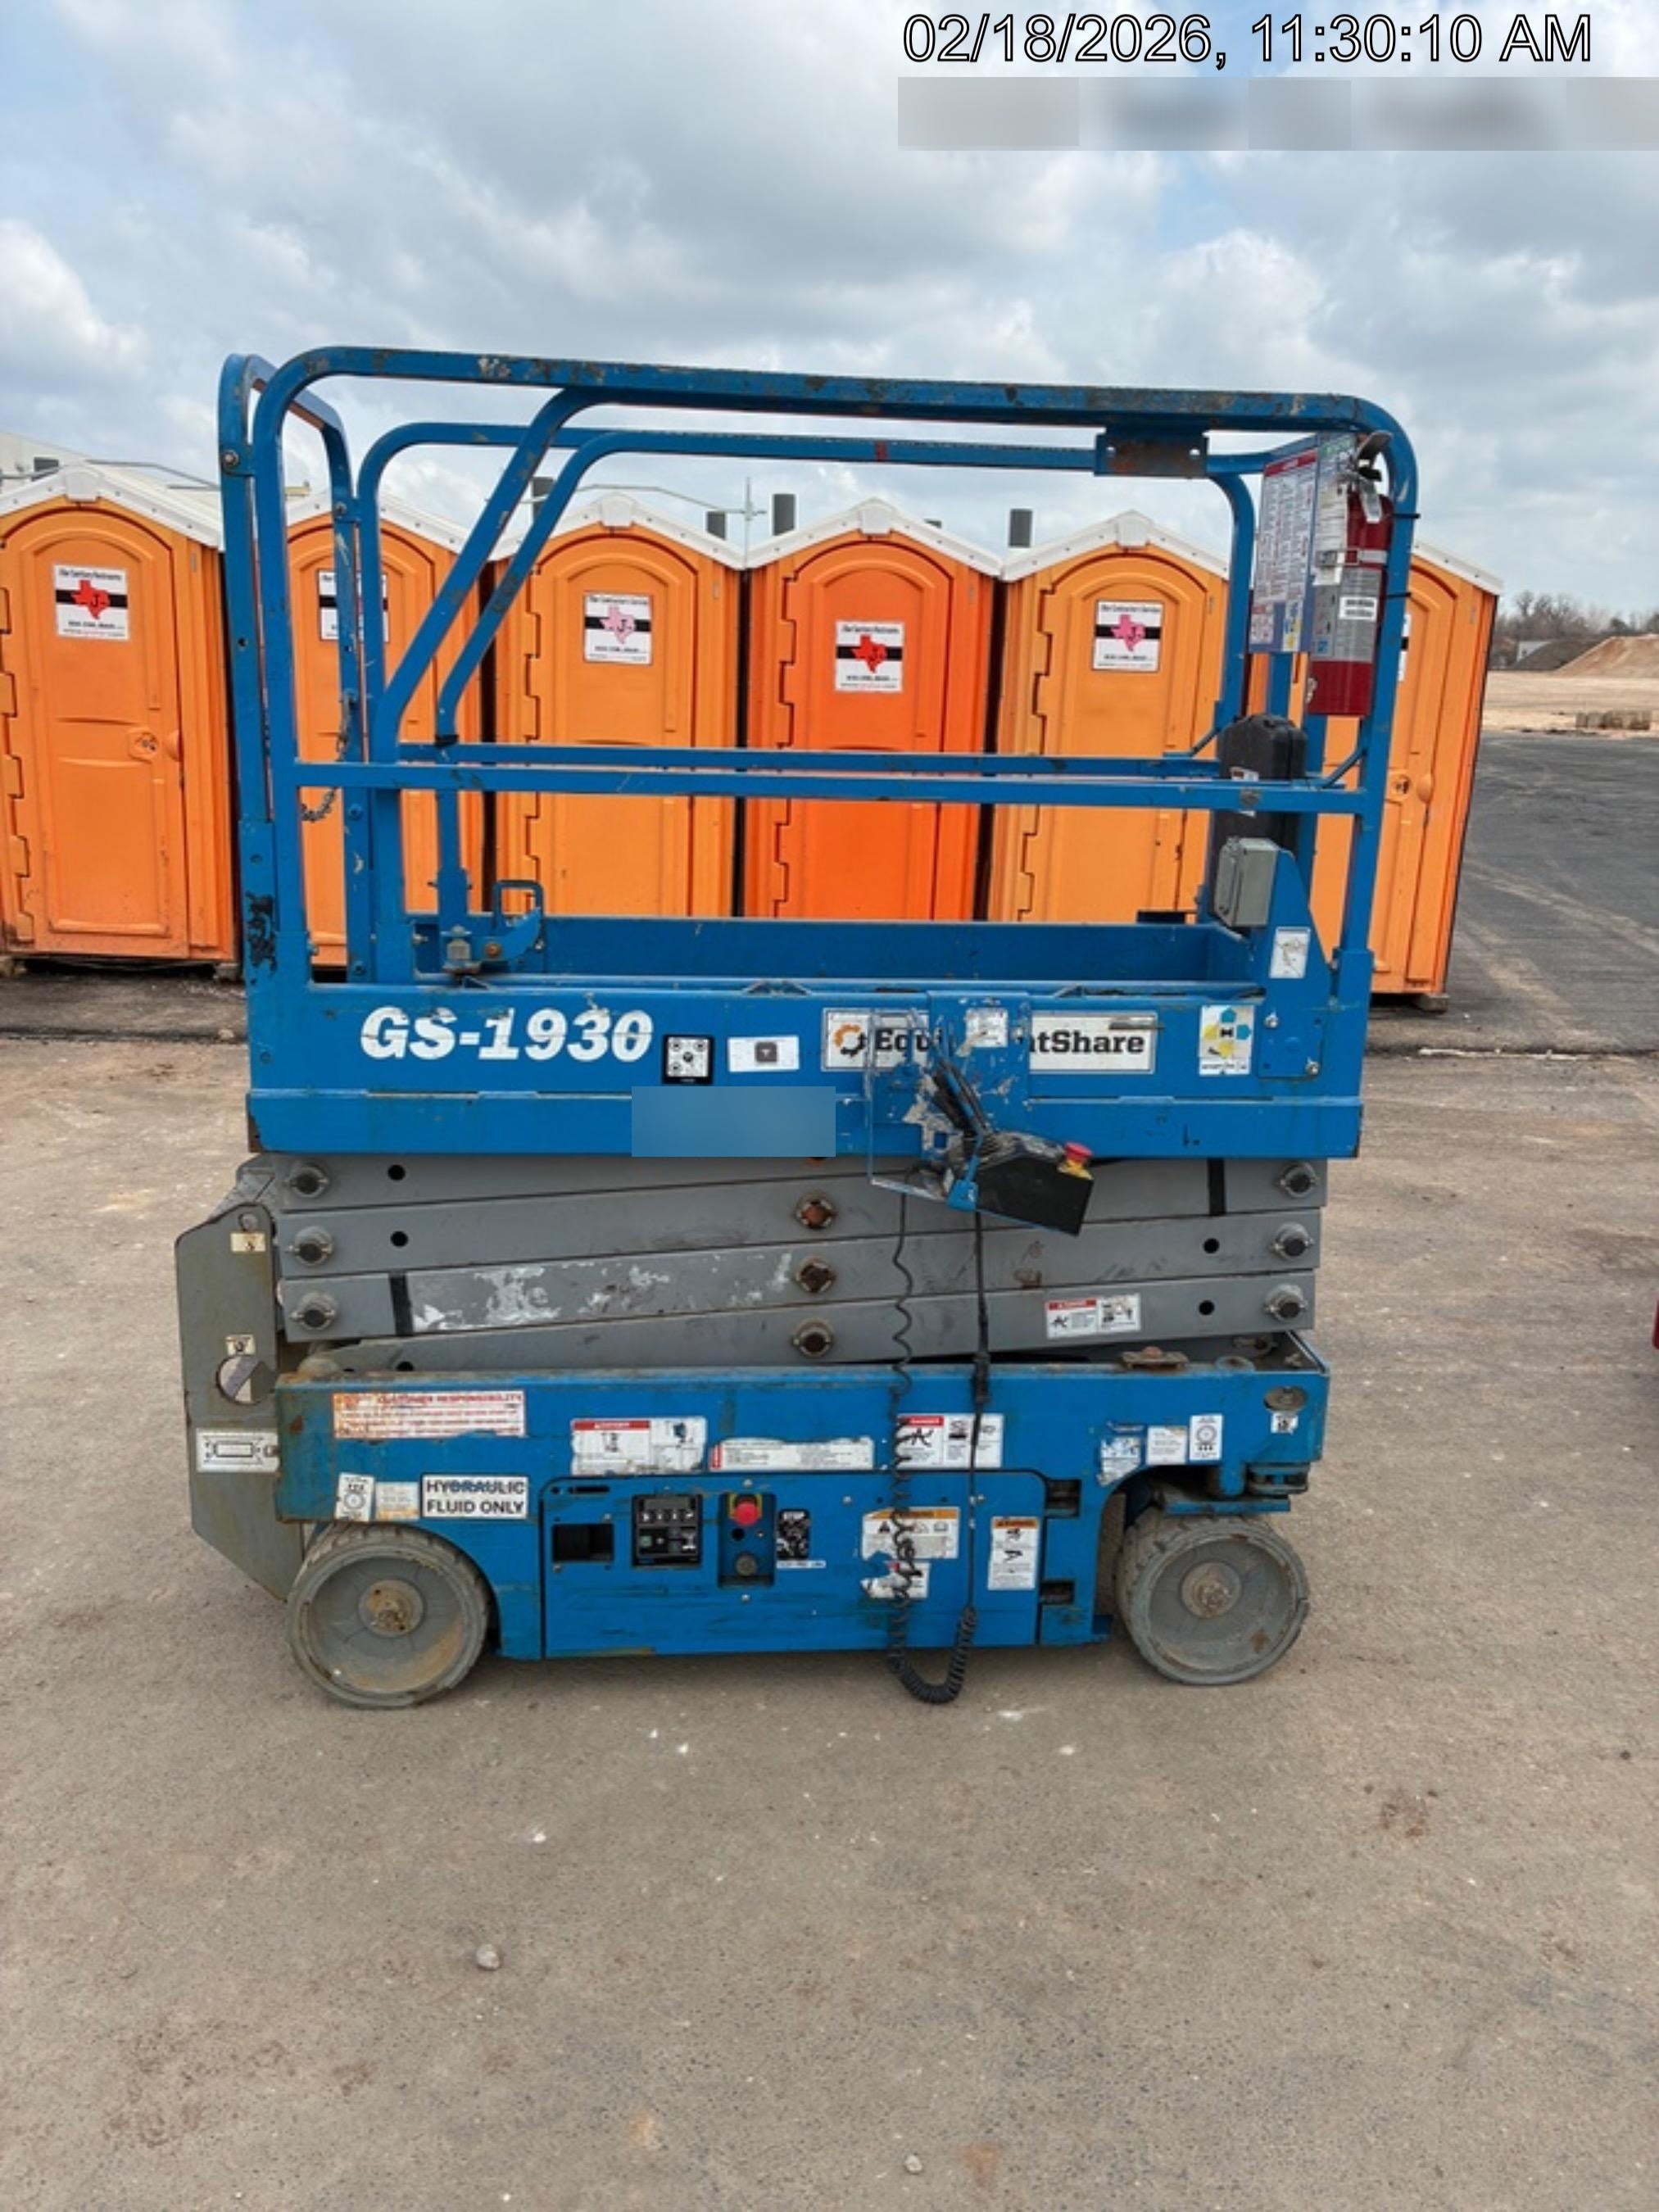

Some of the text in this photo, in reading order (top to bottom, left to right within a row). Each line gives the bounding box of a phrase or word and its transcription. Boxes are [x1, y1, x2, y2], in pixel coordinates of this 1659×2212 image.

[360, 1006, 653, 1062] GS-1930
[427, 1480, 524, 1494] HYDRAULIC
[427, 1498, 475, 1514] FLUID
[480, 1499, 524, 1514] ONLY
